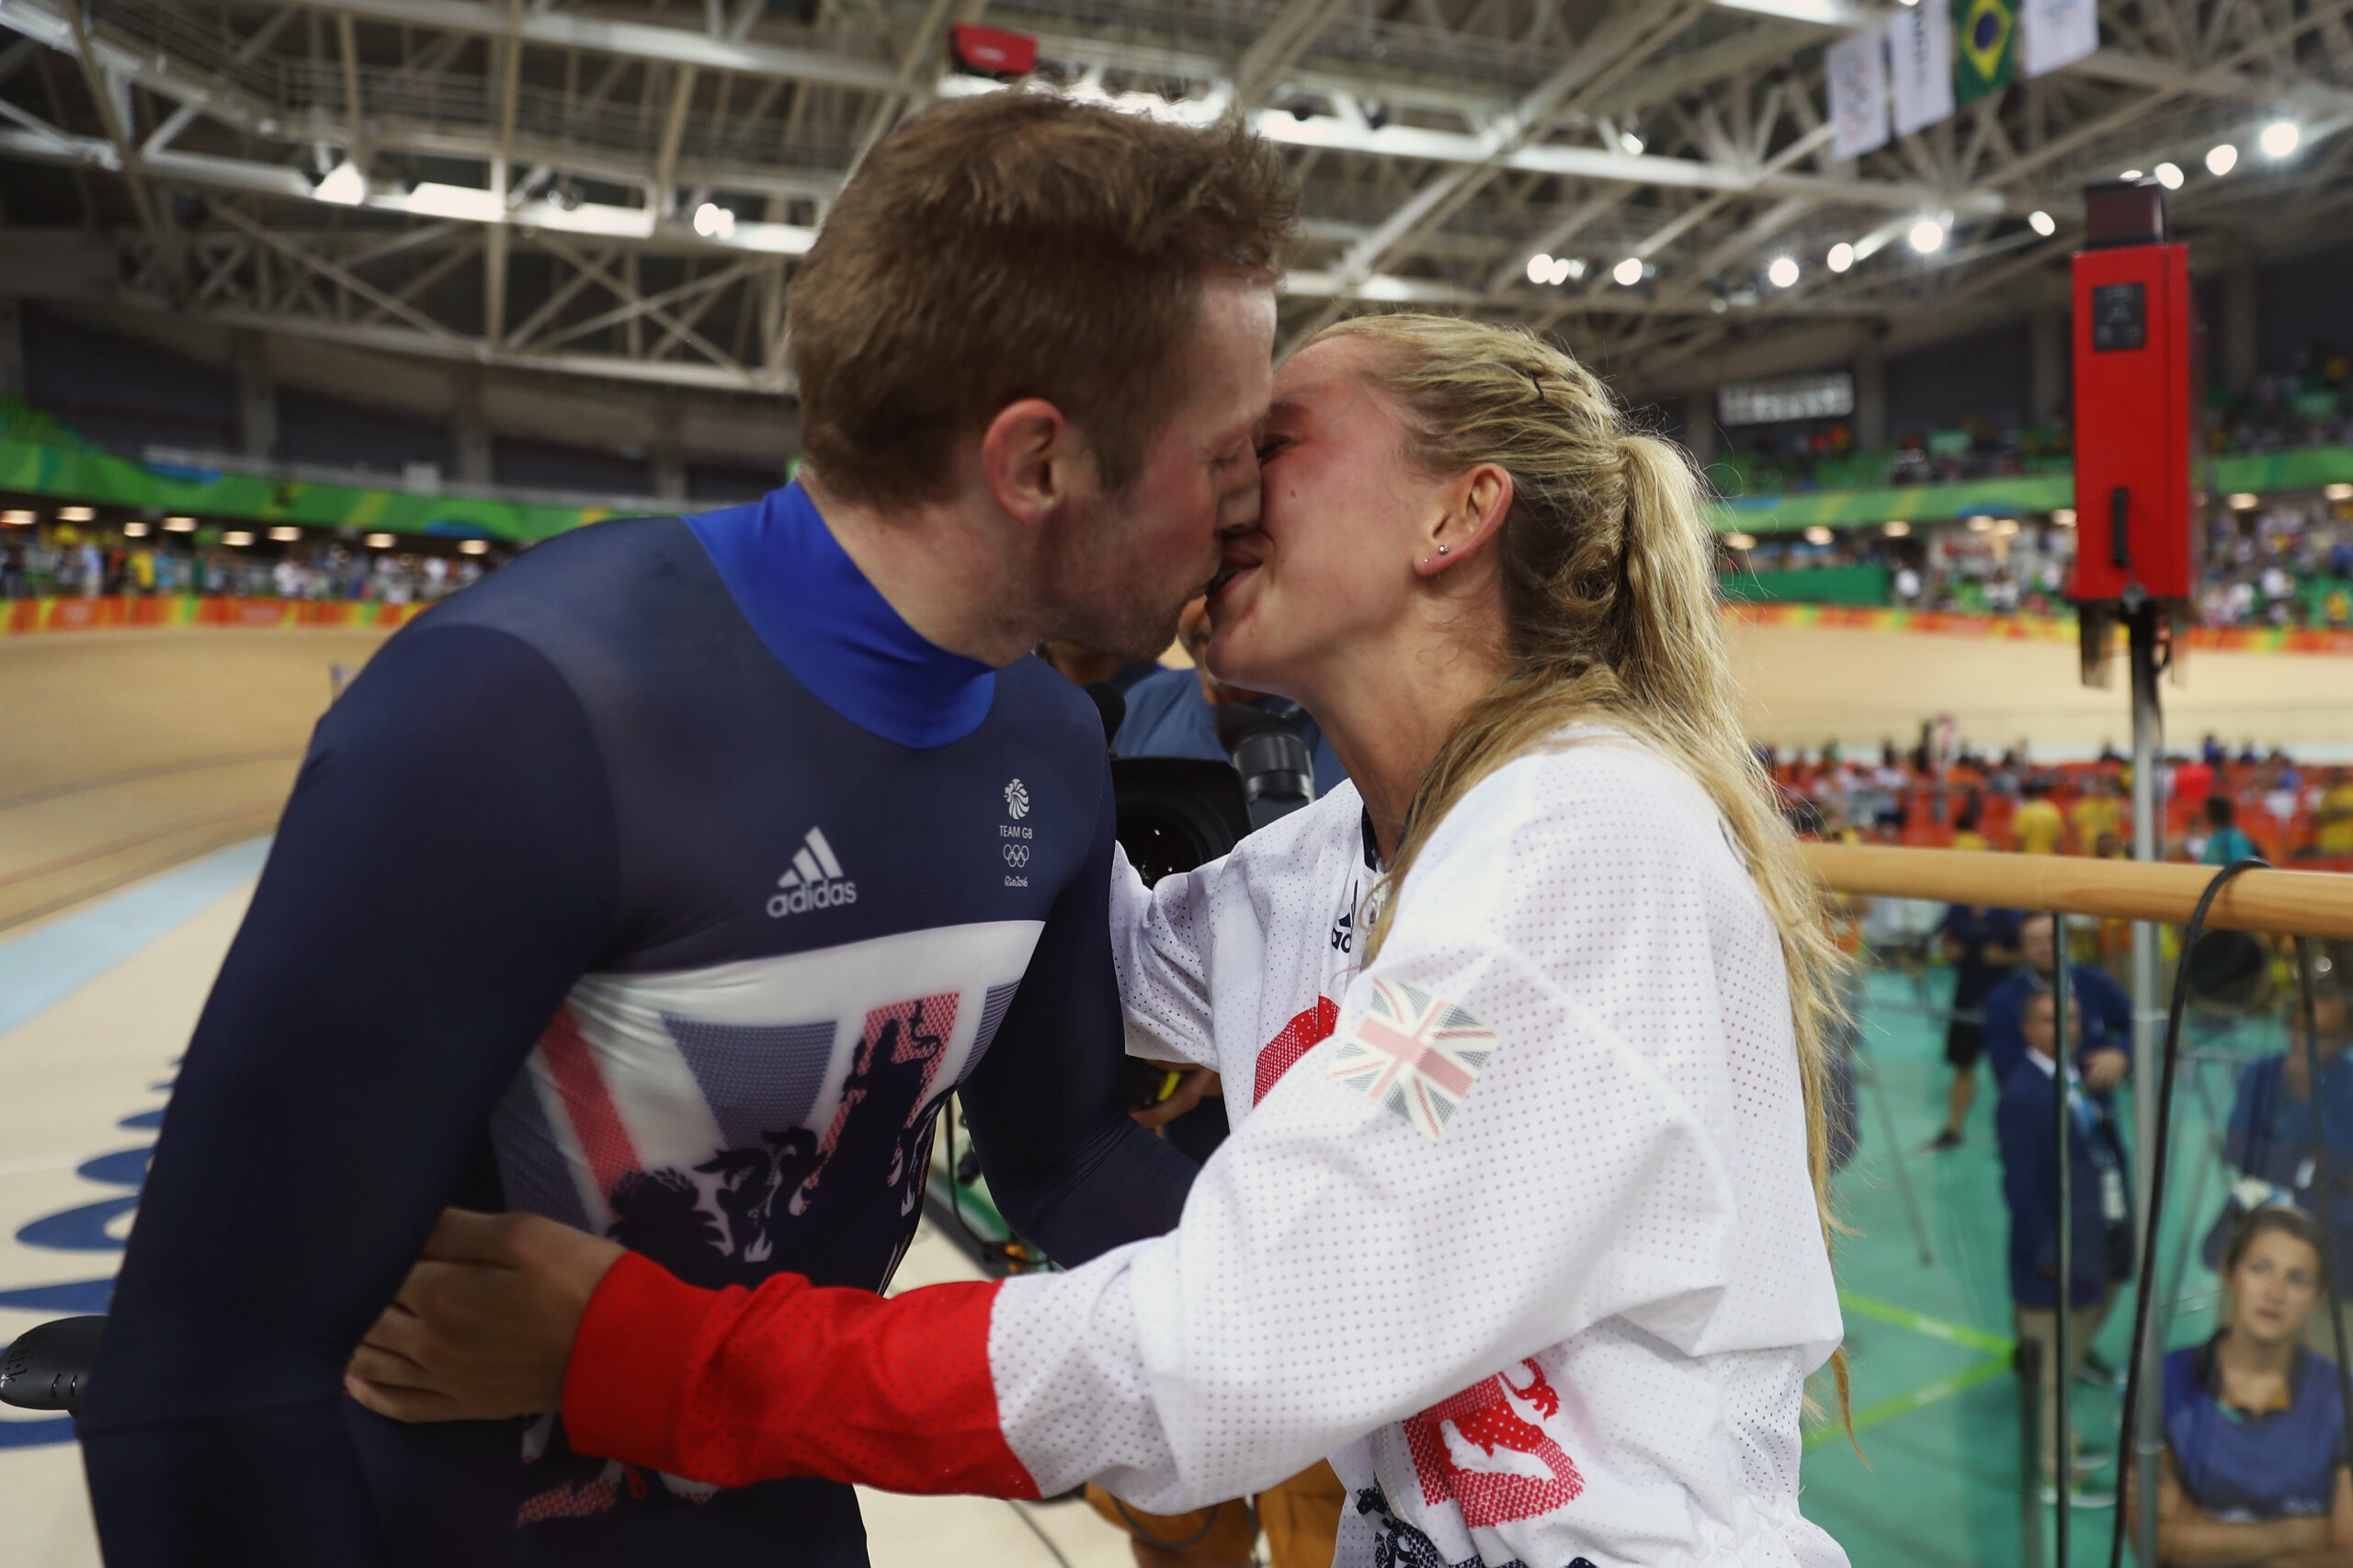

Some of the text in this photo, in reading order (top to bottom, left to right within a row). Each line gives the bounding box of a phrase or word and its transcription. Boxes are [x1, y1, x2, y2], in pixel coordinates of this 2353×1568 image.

[1000, 825, 1033, 839] TEAM GB
[767, 880, 857, 918] adidas
